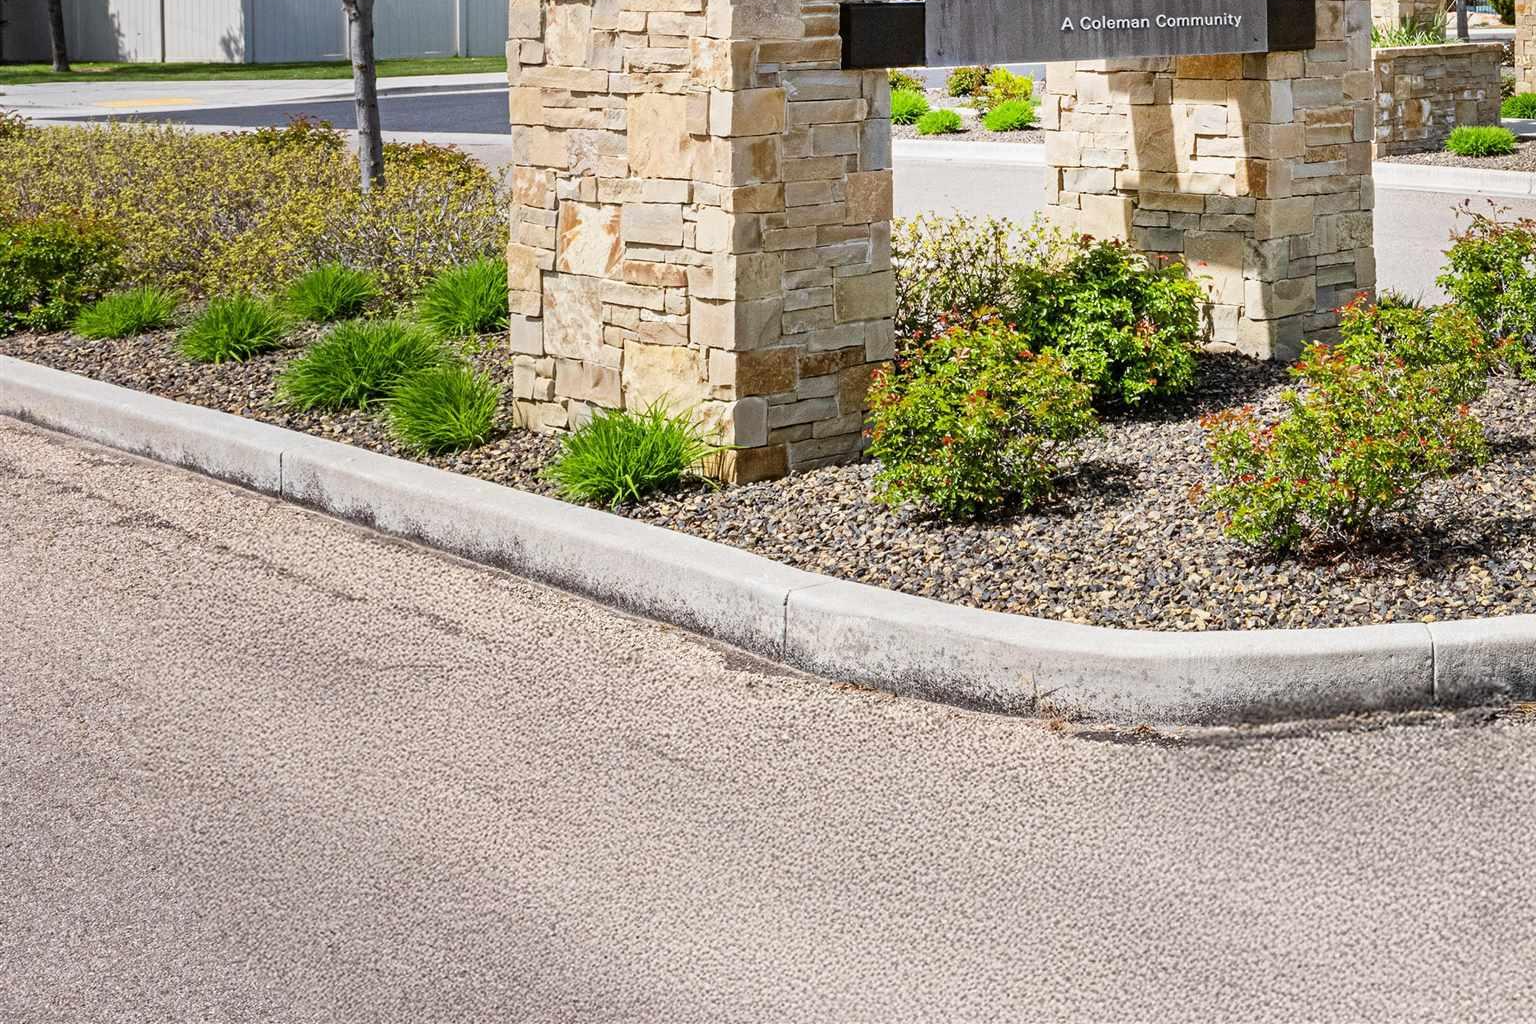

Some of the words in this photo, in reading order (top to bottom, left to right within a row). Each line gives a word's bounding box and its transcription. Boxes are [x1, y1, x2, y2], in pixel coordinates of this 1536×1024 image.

[1060, 17, 1075, 31] A
[1079, 16, 1151, 31] Coleman
[1155, 12, 1243, 28] Community
